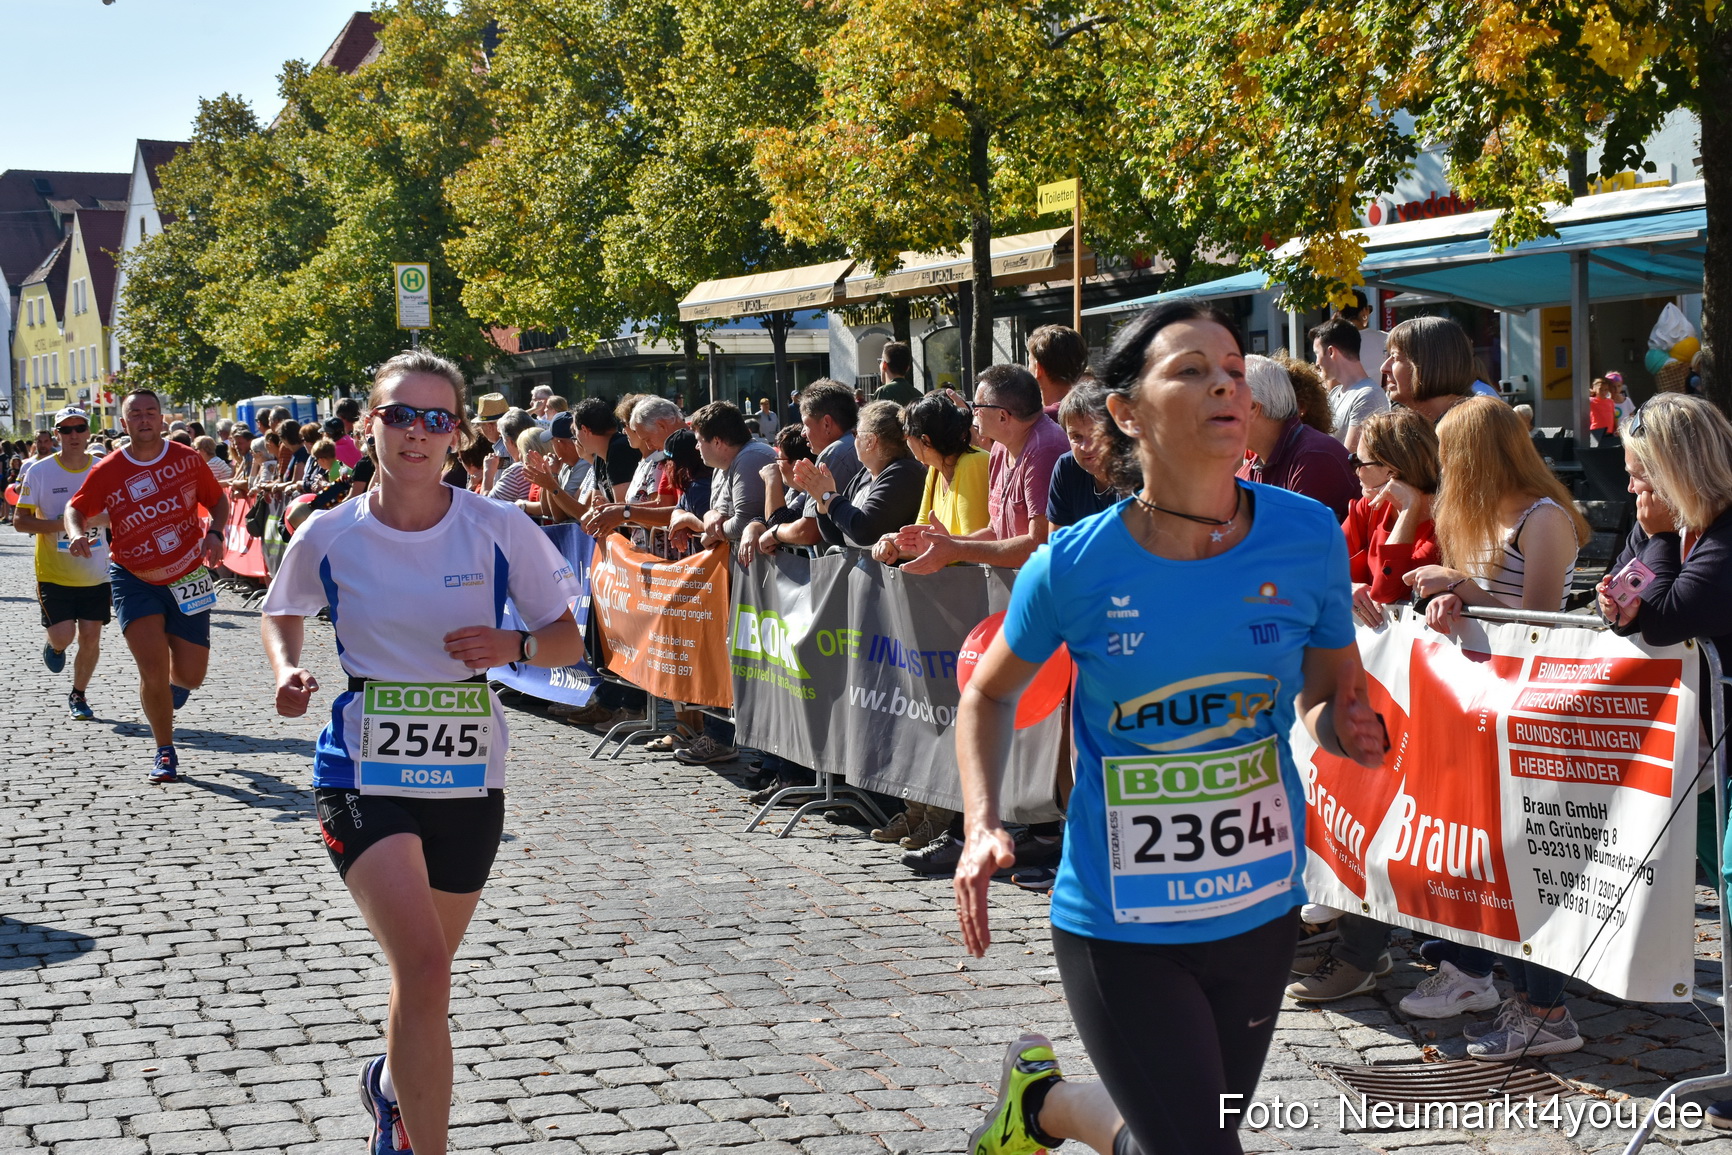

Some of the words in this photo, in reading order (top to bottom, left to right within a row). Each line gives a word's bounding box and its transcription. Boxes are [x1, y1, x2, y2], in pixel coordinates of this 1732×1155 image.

[1044, 189, 1075, 204] Toiletten
[406, 273, 419, 287] H
[178, 579, 211, 600] 2262
[672, 592, 702, 604] Internet,
[659, 604, 687, 620] Werbung
[688, 608, 714, 622] angeht.
[1107, 609, 1139, 618] erima
[670, 634, 681, 645] bei
[682, 638, 696, 648] uns:
[1249, 623, 1280, 646] TUM
[549, 667, 565, 688] GET
[678, 665, 693, 677] 897
[374, 686, 485, 713] BOCK
[377, 721, 479, 758] 2545
[1515, 722, 1641, 750] RUNDSCHLINGEN
[400, 769, 455, 785] ROSA
[1119, 746, 1270, 801] BOCK
[1518, 756, 1621, 782] HEBEBÄNDER
[1303, 760, 1366, 861] Braun
[1523, 796, 1561, 816] Braun
[1565, 800, 1608, 820] GmbH
[1131, 800, 1276, 864] 2364
[1389, 792, 1496, 884] Braun
[1525, 818, 1546, 836] Am
[1549, 820, 1609, 847] Grünberg
[1611, 828, 1618, 845] 8
[1338, 850, 1348, 864] ist
[1527, 838, 1581, 860] D-92318
[1167, 870, 1254, 901] ILONA
[1427, 879, 1460, 900] Sicher
[1462, 887, 1478, 903] ist
[1480, 891, 1514, 910] sicher
[1533, 868, 1558, 886] Tel.
[1560, 870, 1591, 894] 09181
[1598, 879, 1624, 905] 2307-0
[1537, 888, 1561, 908] Fax
[1563, 892, 1590, 916] 09181
